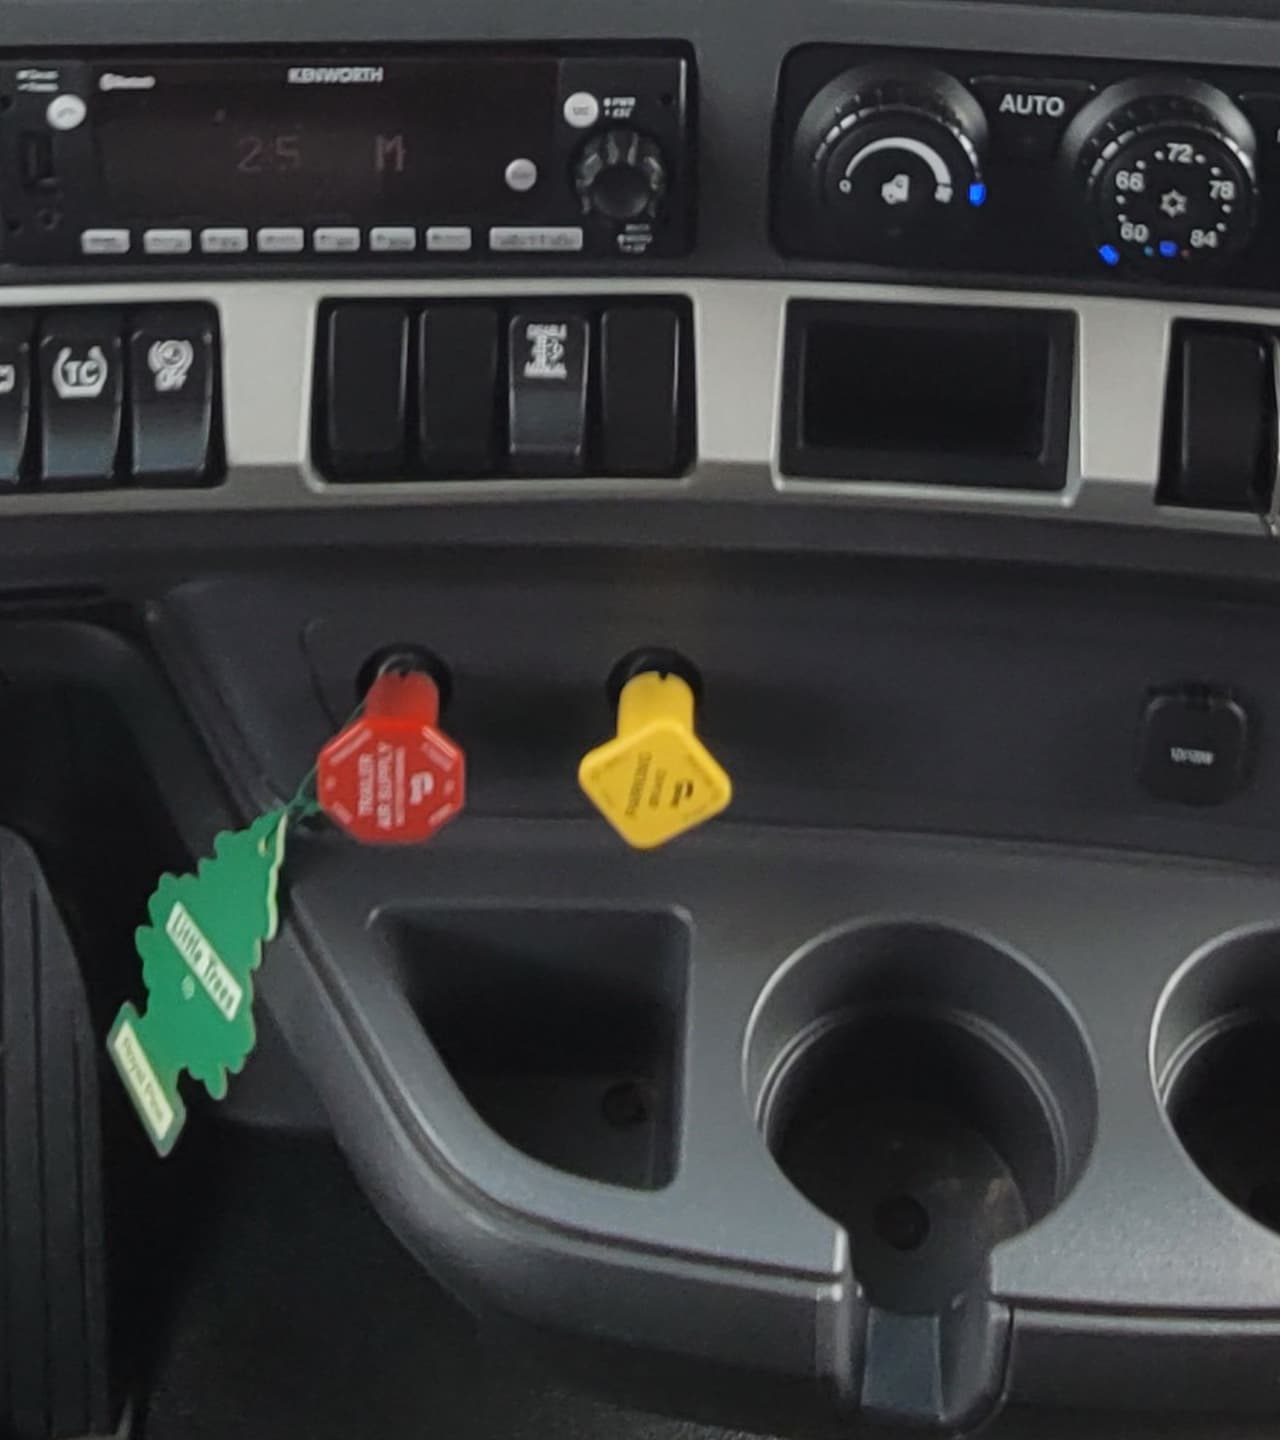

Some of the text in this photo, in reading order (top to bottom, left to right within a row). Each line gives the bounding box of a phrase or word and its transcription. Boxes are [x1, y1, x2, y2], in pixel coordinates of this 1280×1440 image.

[287, 66, 385, 84] KENWORTH
[998, 93, 1066, 118] AUTO
[1165, 142, 1195, 164] 72
[1115, 170, 1145, 193] 66
[1209, 179, 1235, 200] 78
[1120, 222, 1150, 244] 60
[1189, 229, 1219, 250] 84
[62, 359, 102, 387] TC
[376, 741, 394, 801] SUPPLY
[171, 911, 236, 1012] Little Trees
